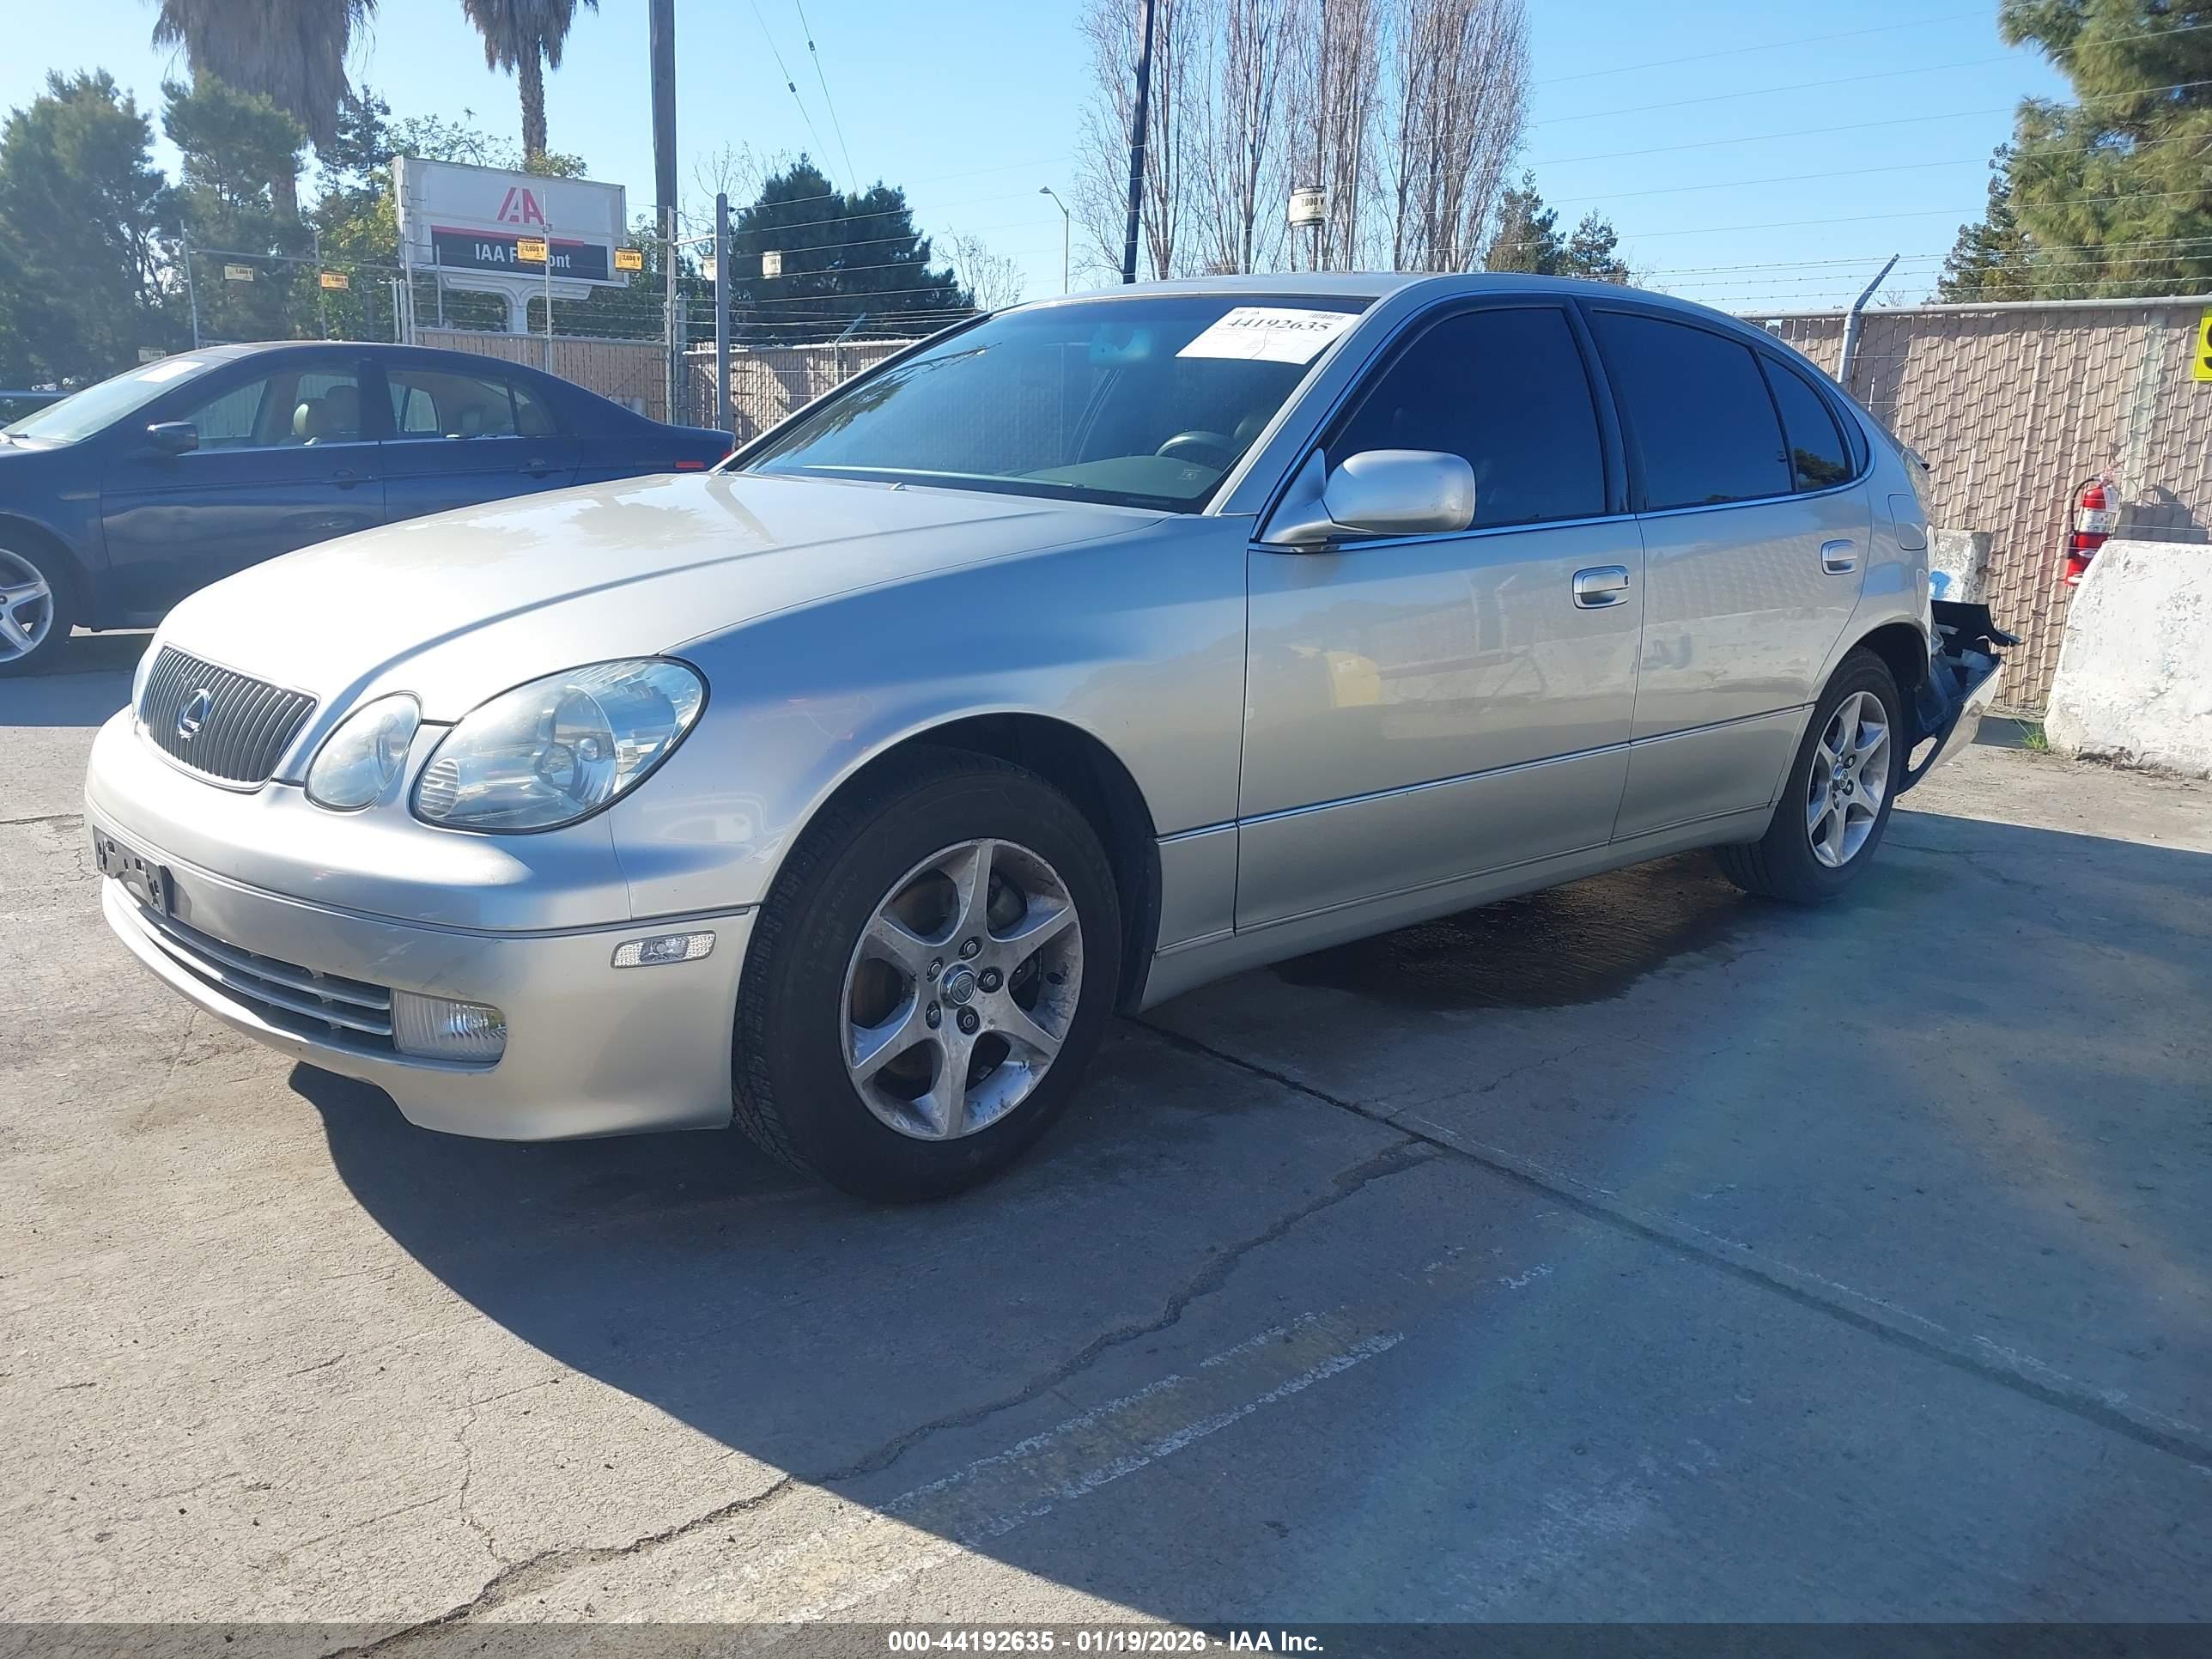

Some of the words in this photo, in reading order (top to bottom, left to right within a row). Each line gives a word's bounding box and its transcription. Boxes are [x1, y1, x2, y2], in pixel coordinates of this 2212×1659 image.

[1320, 197, 1325, 206] V
[475, 243, 505, 262] IAA
[509, 246, 571, 269] Font
[1227, 318, 1333, 331] 44192635
